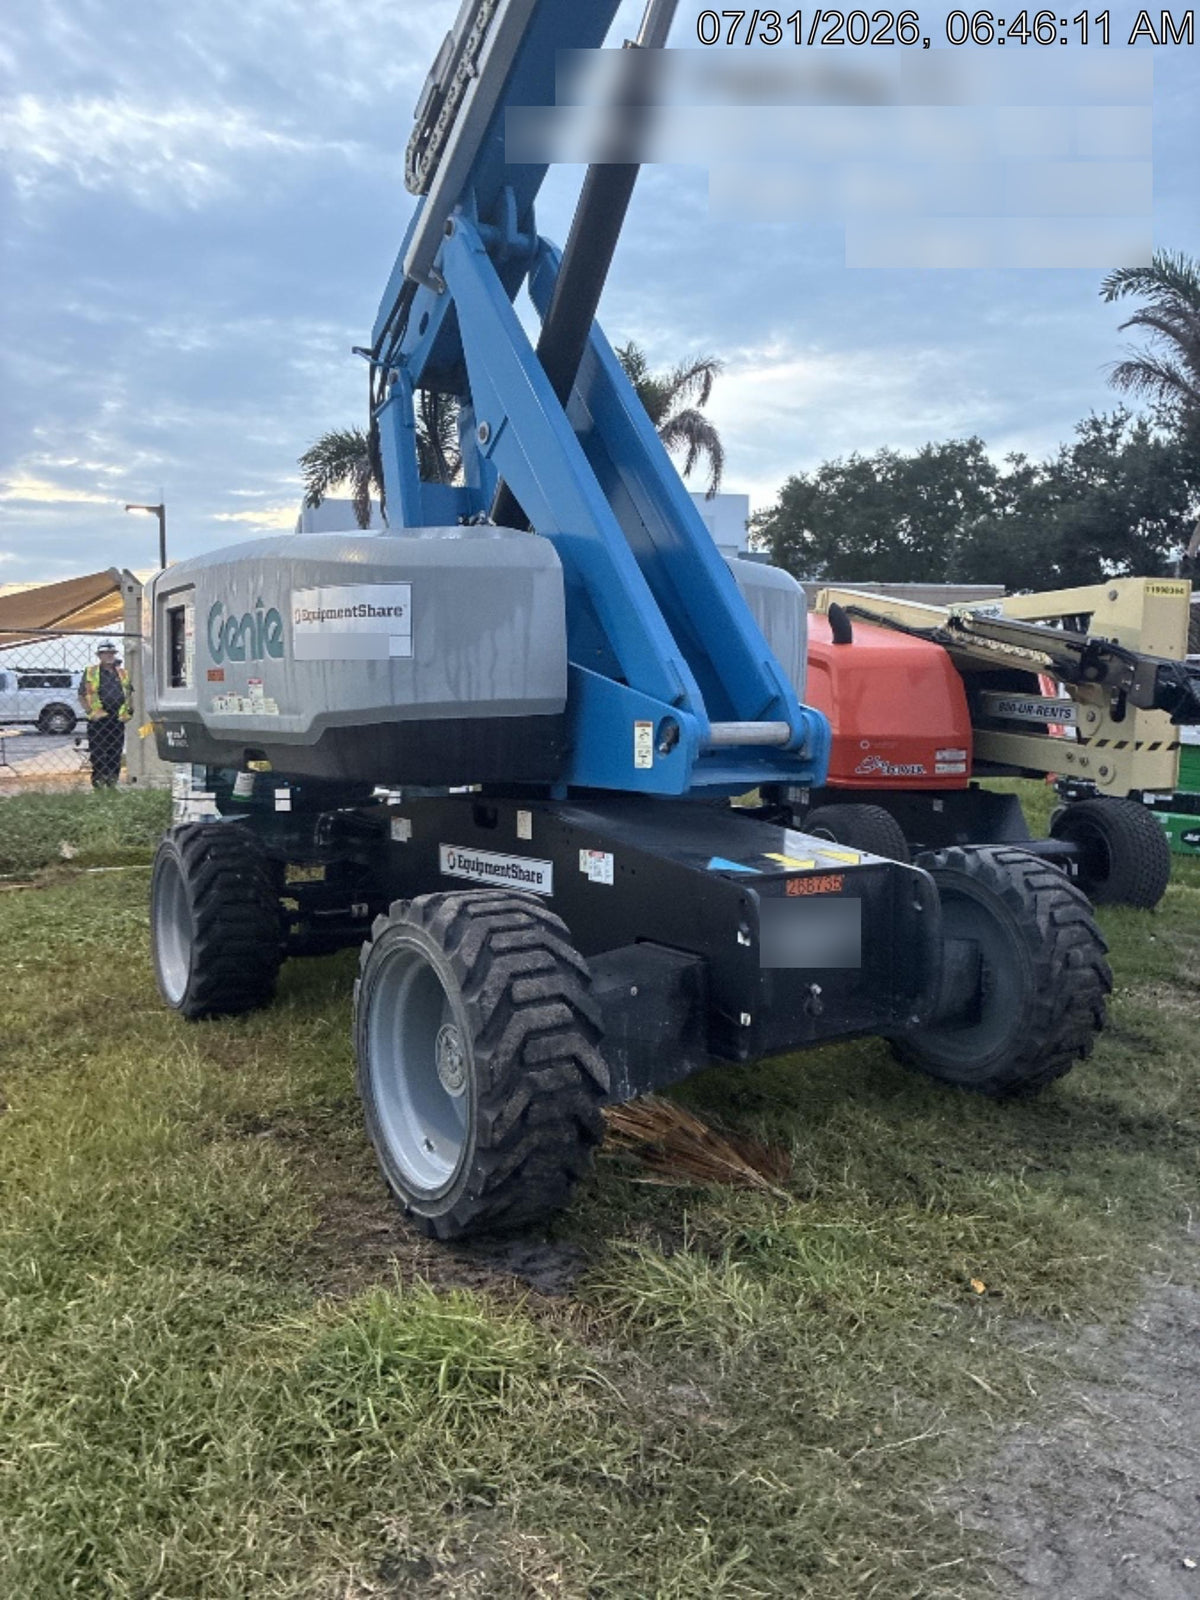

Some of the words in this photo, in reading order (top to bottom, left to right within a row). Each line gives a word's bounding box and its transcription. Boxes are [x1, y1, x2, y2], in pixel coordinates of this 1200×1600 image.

[302, 603, 403, 622] EquipmentShare
[207, 596, 284, 665] Genie
[458, 854, 543, 884] EquipmentShare
